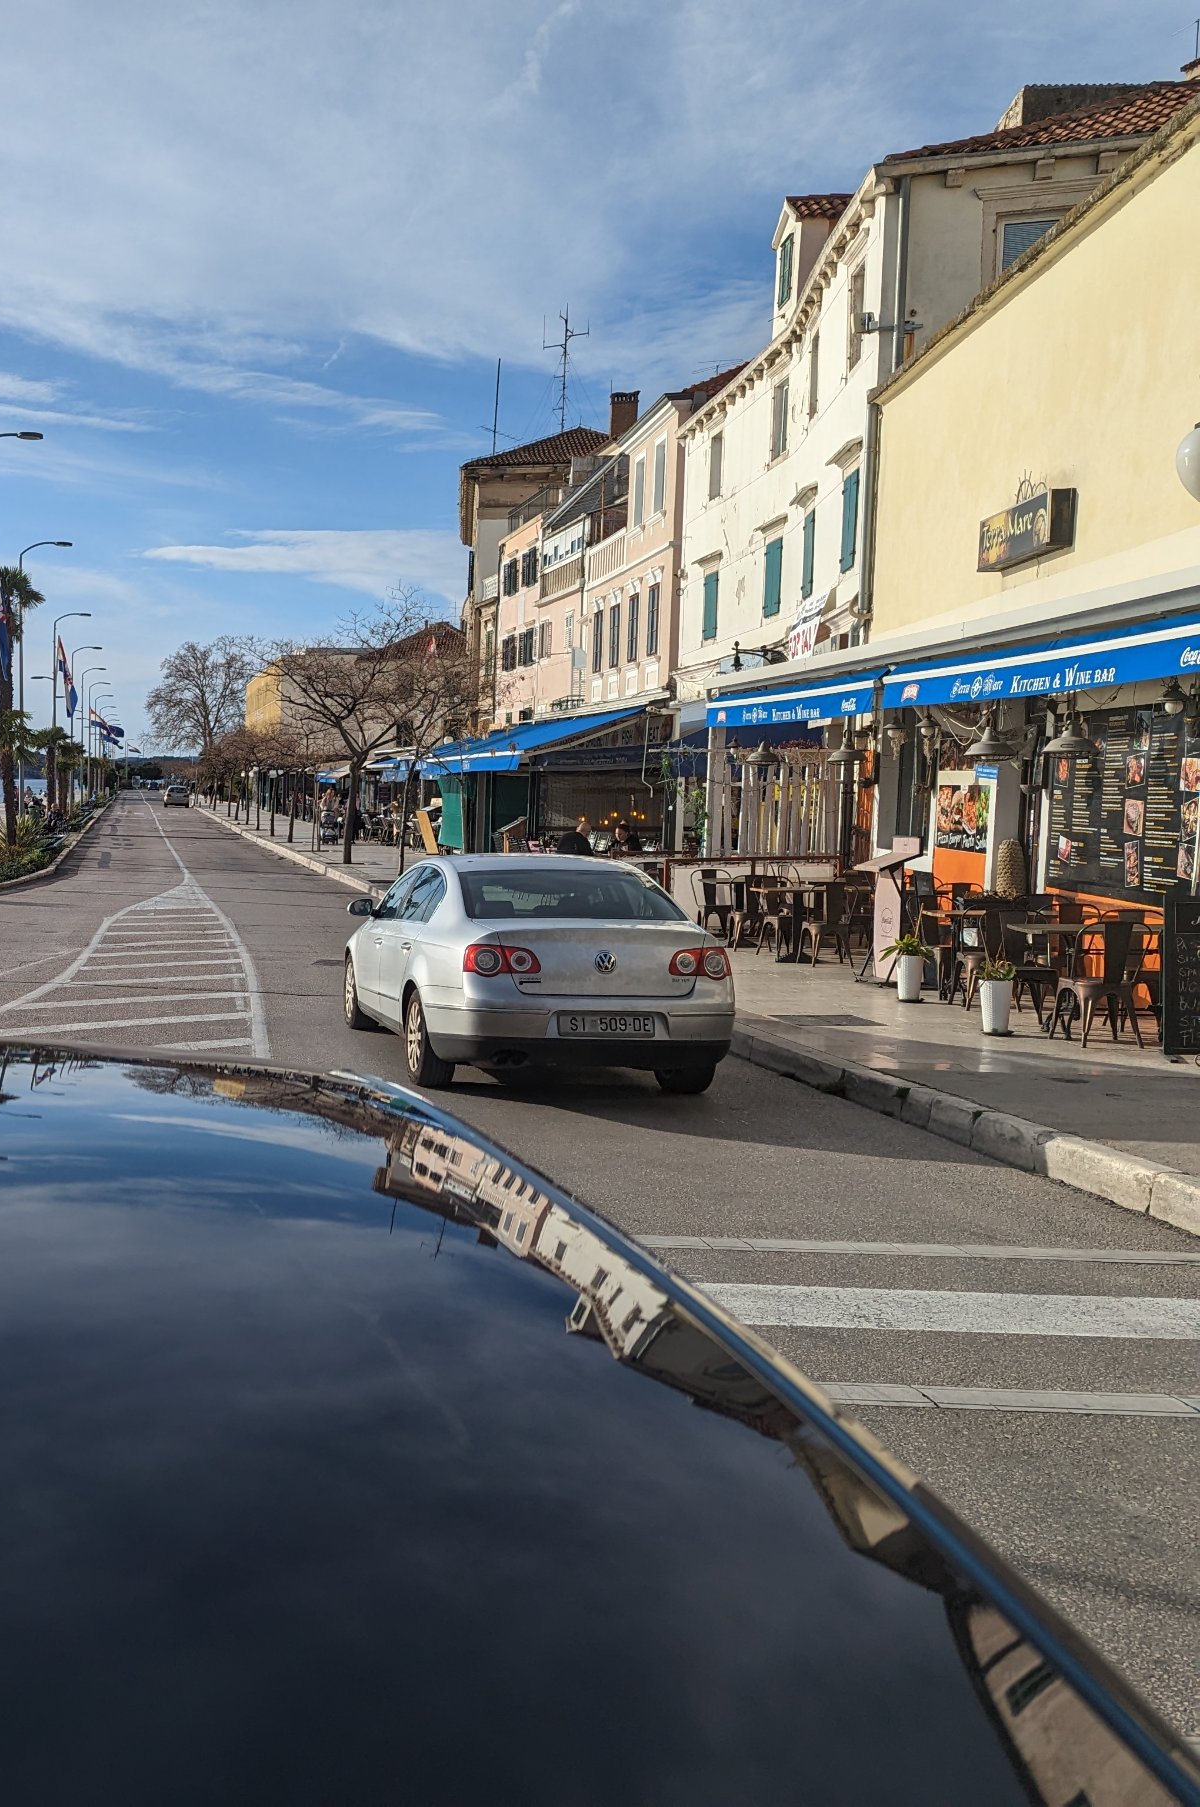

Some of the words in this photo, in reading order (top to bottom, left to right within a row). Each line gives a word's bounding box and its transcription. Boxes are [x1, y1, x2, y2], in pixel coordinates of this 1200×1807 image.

[982, 524, 1006, 549] Terra
[1007, 511, 1033, 537] Mare
[1052, 672, 1061, 689] &
[1093, 667, 1117, 684] BAR
